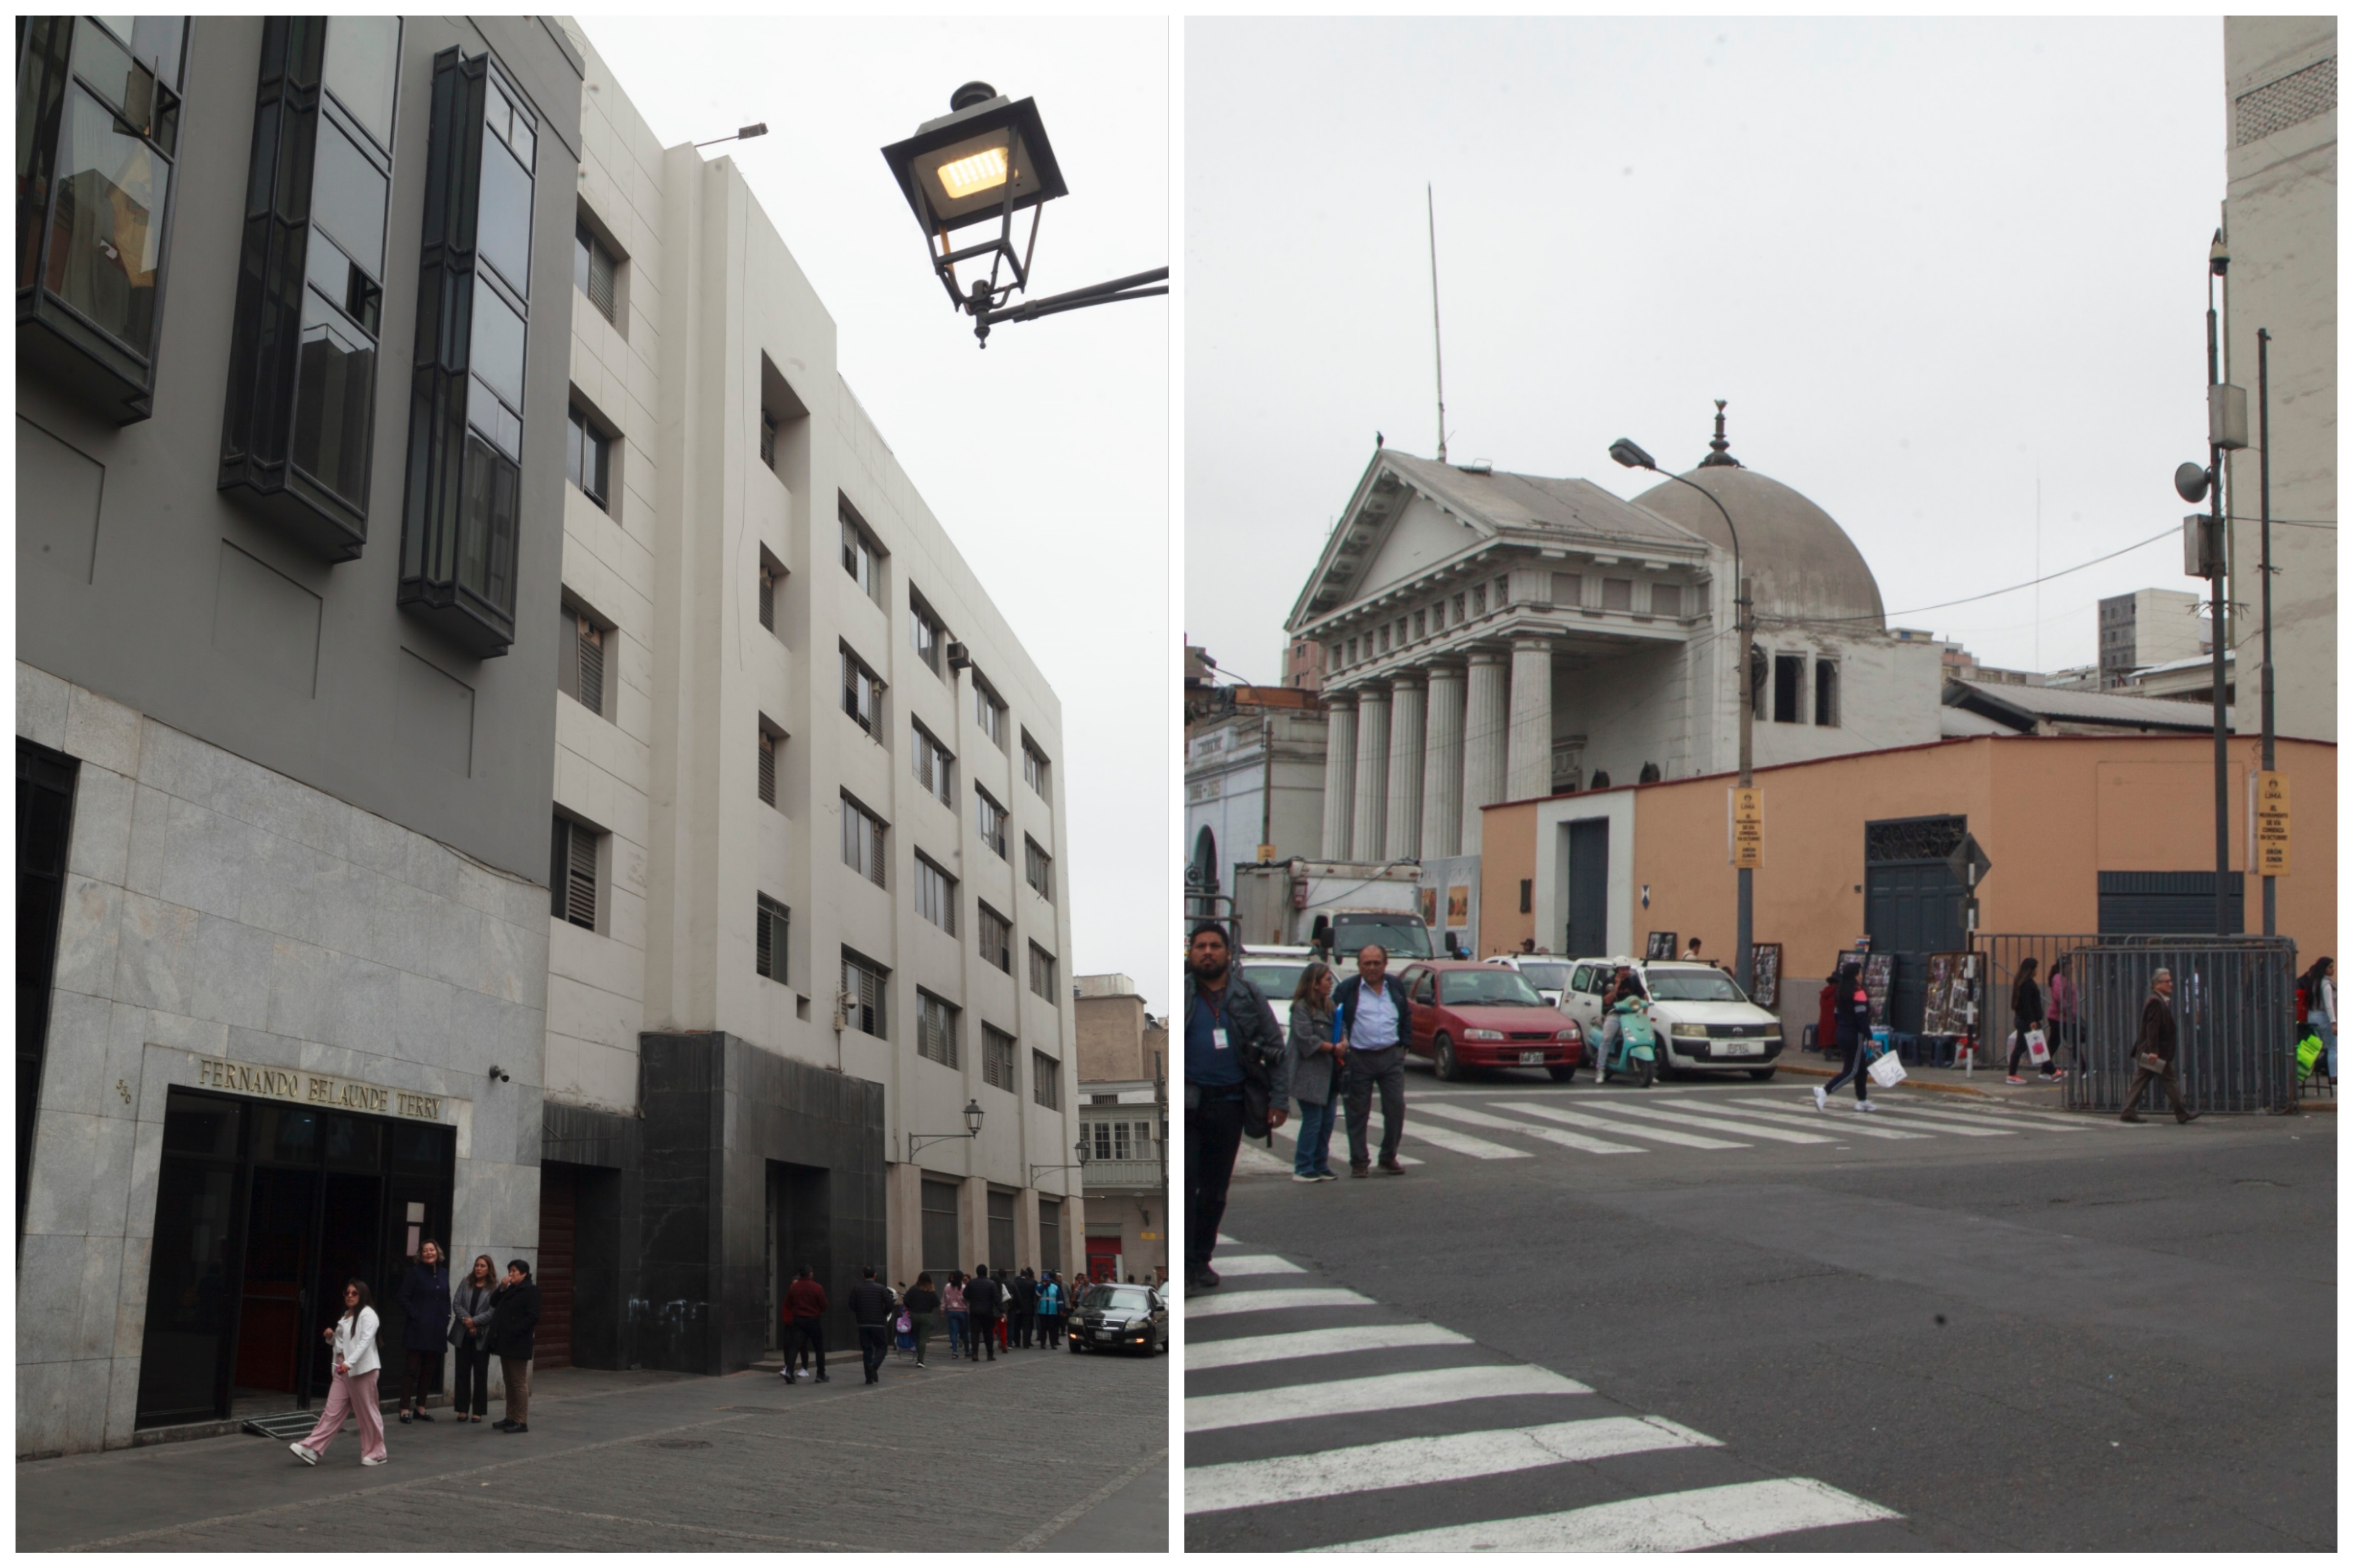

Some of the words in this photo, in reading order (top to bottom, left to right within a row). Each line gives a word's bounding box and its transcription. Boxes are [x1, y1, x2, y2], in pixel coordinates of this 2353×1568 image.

[116, 1080, 131, 1104] 330
[199, 1060, 298, 1097] FERNANDO
[308, 1078, 388, 1111] BELAUNDE
[397, 1093, 441, 1119] TERRY
